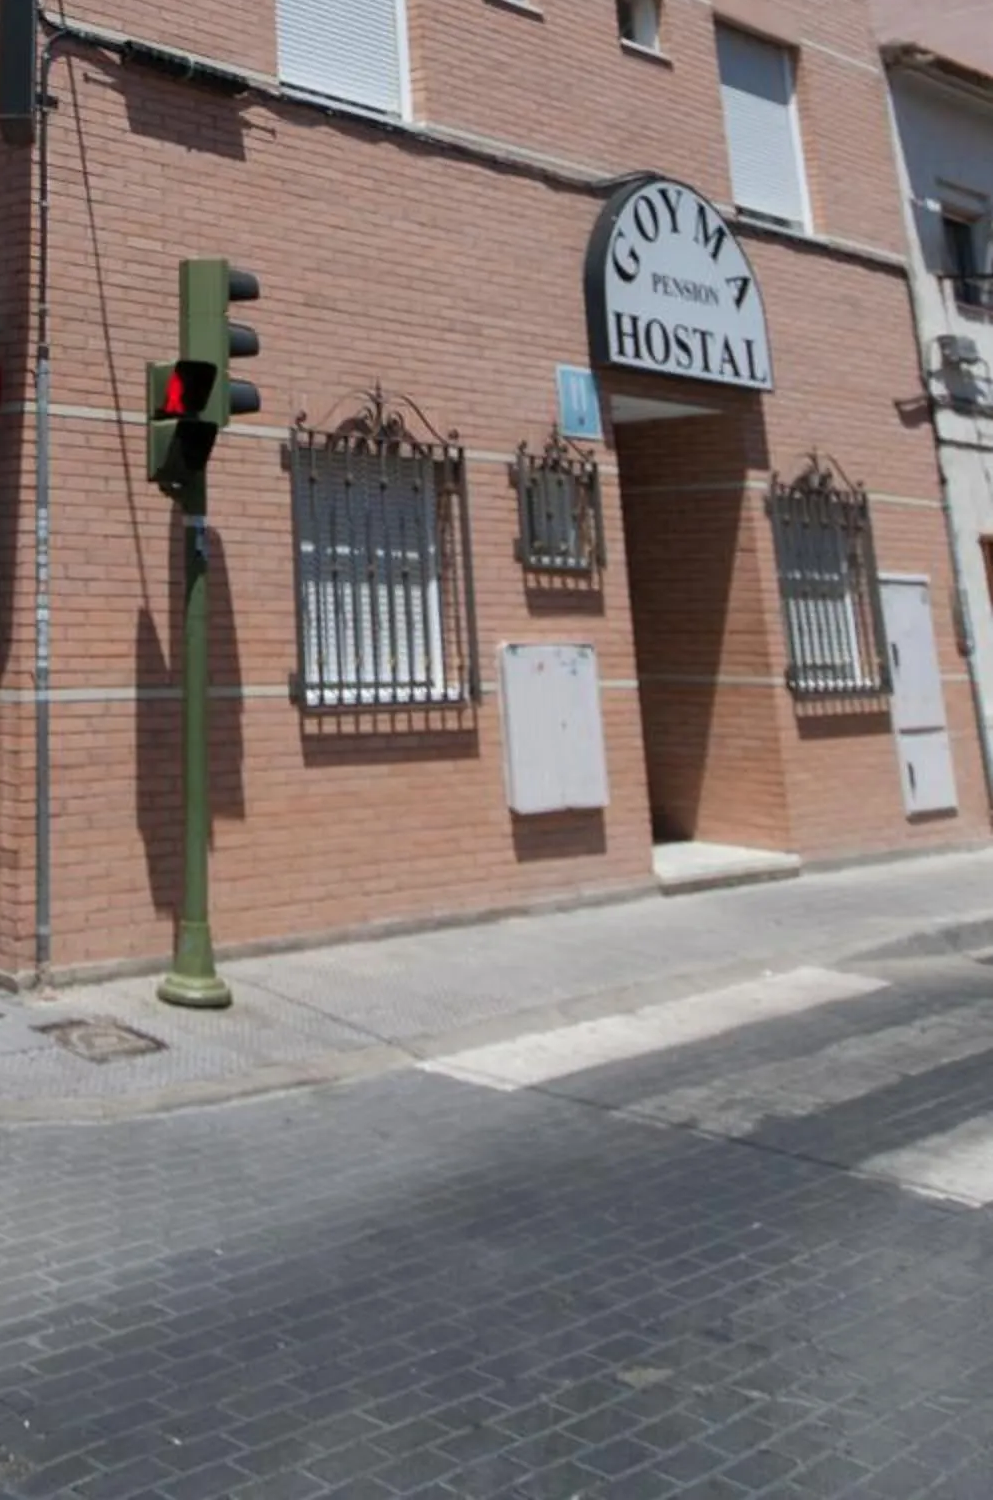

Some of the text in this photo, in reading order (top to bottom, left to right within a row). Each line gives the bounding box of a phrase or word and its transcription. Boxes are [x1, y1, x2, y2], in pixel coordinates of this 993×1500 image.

[612, 188, 752, 311] GOYMA
[651, 273, 720, 306] PENSION
[613, 310, 768, 383] HOSTAL
